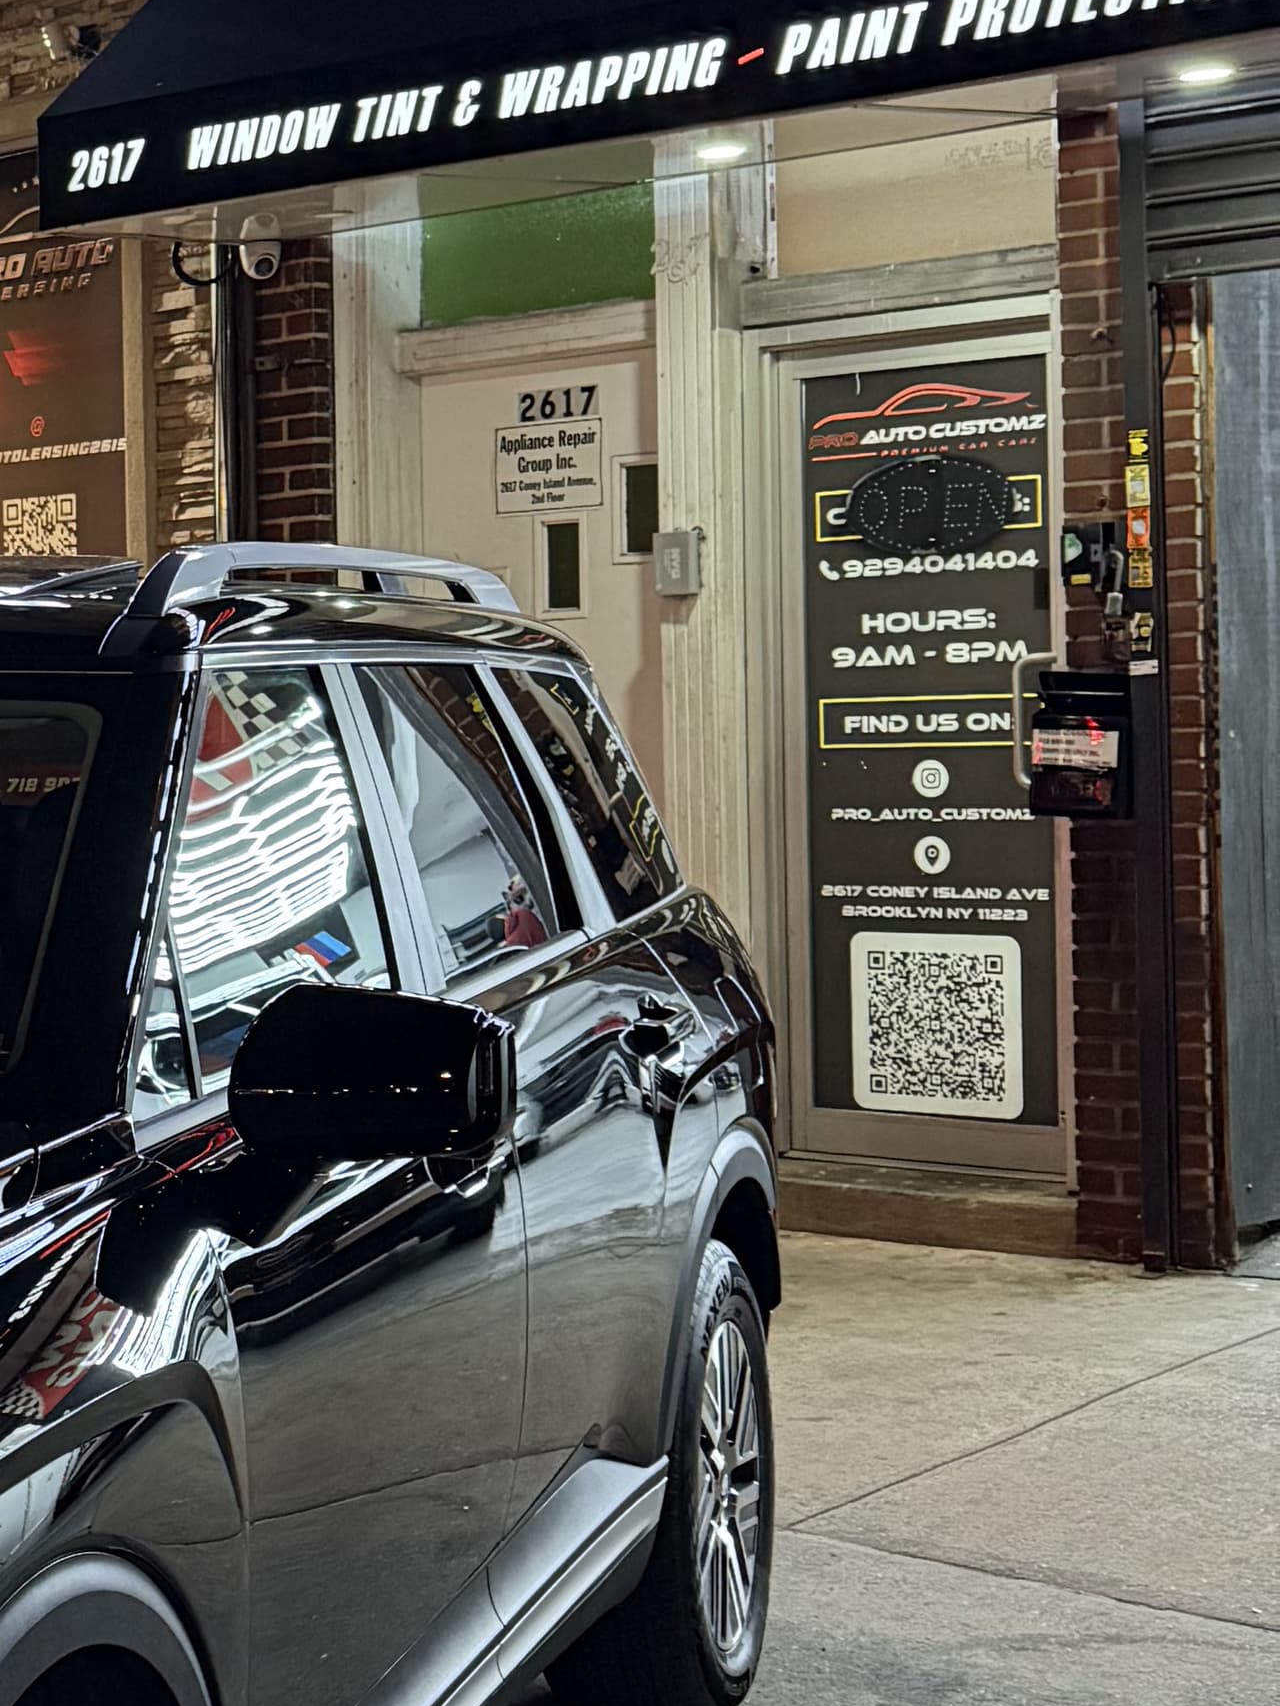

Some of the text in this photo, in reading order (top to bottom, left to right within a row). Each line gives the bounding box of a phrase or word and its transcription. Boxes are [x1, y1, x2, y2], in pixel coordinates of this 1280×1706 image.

[67, 139, 145, 193] 2617
[187, 103, 342, 171] WINDOW
[352, 85, 443, 144] TINT
[452, 79, 482, 128] &
[498, 37, 728, 121] WRAPPING
[775, 1, 929, 76] PAINT
[30, 236, 114, 277] AUTO
[519, 384, 598, 423] 2617
[30, 415, 45, 438] @
[808, 413, 1047, 450] PRO AUTO CUSTOMZ
[500, 426, 597, 456] Appliance Repair
[958, 441, 989, 452] CAR
[517, 453, 577, 475] Group Inc.
[543, 476, 566, 490] Island
[860, 481, 1007, 531] OPEN
[842, 548, 1040, 579] 9294041404
[860, 607, 997, 635] HOURS:
[831, 644, 917, 669] 9AM
[944, 639, 1029, 664] 8PM
[844, 714, 910, 734] FIND
[915, 712, 960, 733] US
[6, 777, 39, 793] 718
[820, 884, 1051, 902] 2617 CONEY ISLAND AVE
[841, 905, 1030, 922] BROOKLYN NY 11223
